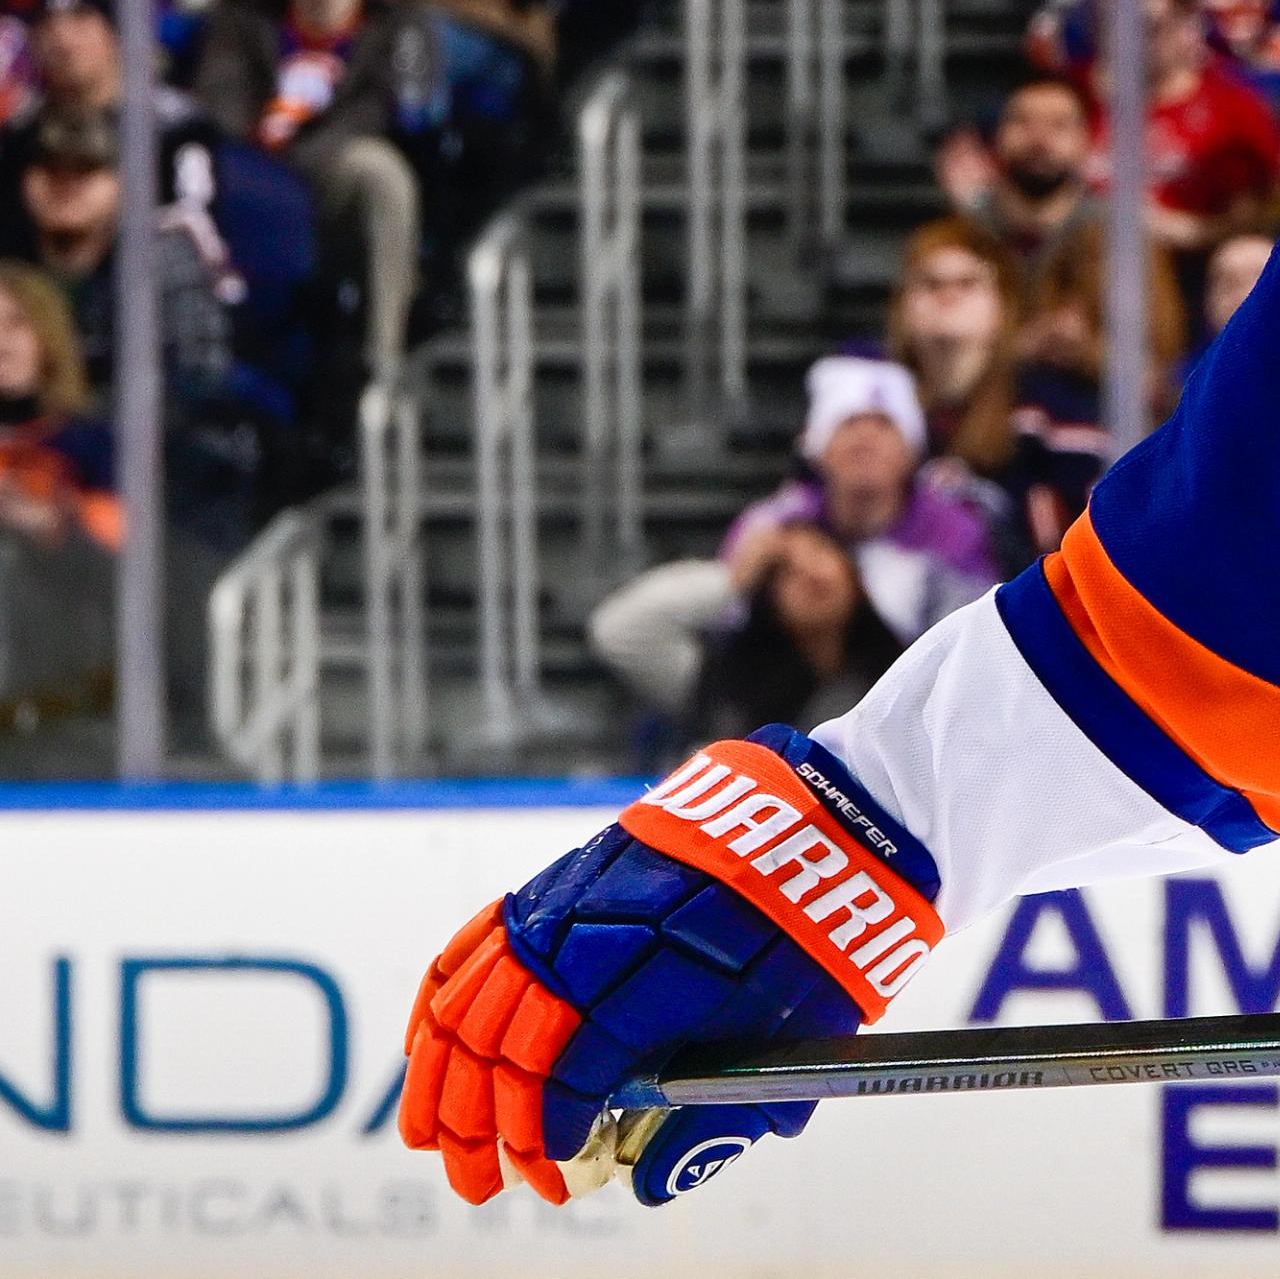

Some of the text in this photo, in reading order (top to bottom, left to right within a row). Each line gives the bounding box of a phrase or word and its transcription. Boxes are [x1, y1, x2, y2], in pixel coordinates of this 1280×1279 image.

[796, 762, 898, 858] SCHAEFER
[857, 1072, 1043, 1095] WARRIOR
[1089, 1062, 1195, 1082] COVERT
